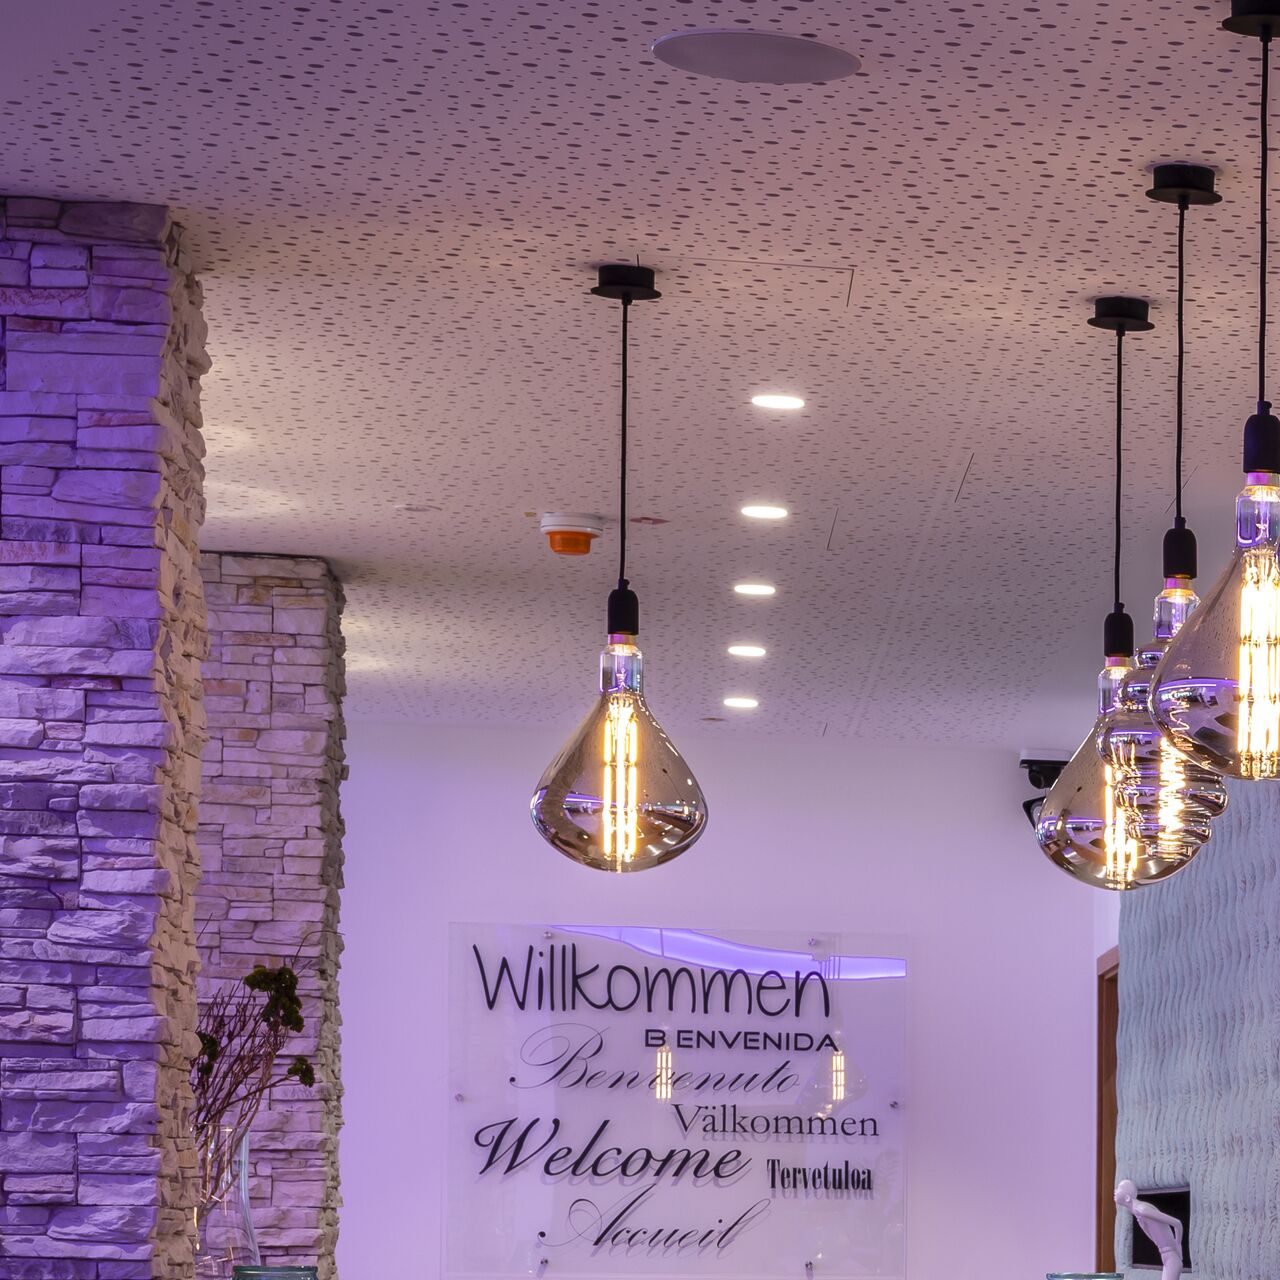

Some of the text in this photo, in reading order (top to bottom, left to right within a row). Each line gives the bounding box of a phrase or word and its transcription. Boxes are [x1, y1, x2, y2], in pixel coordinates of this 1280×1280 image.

[472, 942, 831, 1018] Willkommen
[508, 1022, 801, 1091] Benvenuto
[644, 1028, 838, 1053] BENVENIDA
[473, 1116, 753, 1180] Welcome
[671, 1103, 880, 1138] Välkommen
[765, 1158, 873, 1191] Tervetuloa
[537, 1183, 771, 1249] Accueil
